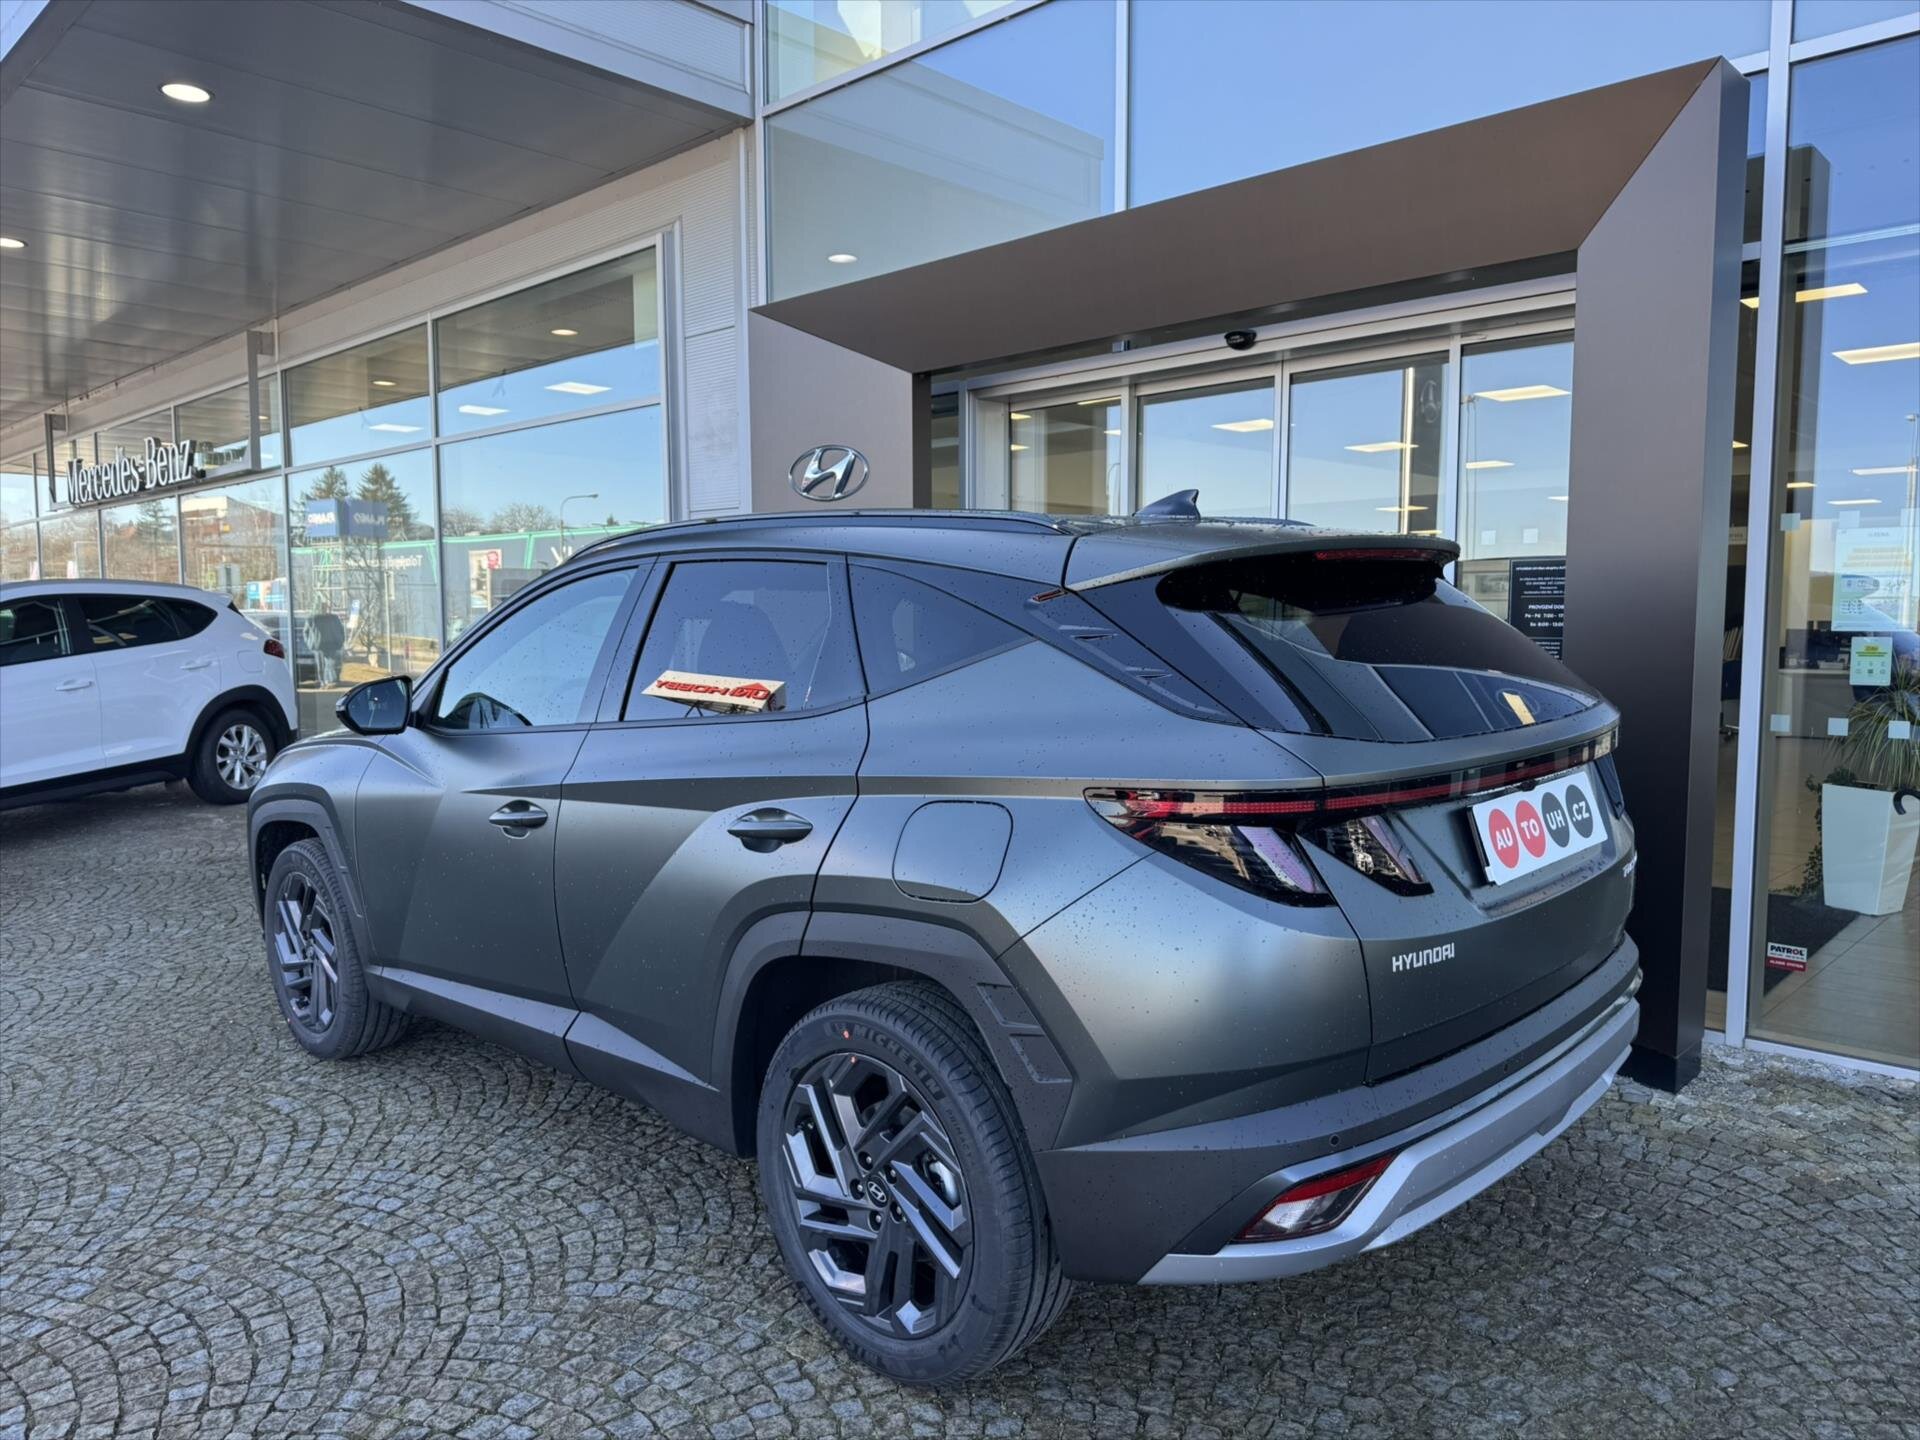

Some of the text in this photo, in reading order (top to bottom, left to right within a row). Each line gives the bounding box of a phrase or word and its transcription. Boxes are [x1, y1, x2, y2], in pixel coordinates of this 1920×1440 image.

[67, 437, 192, 503] Mercedes-Benz
[1391, 942, 1456, 973] HYUNDAI
[1770, 945, 1805, 956] PATROL
[853, 1023, 942, 1096] MICHELIN
